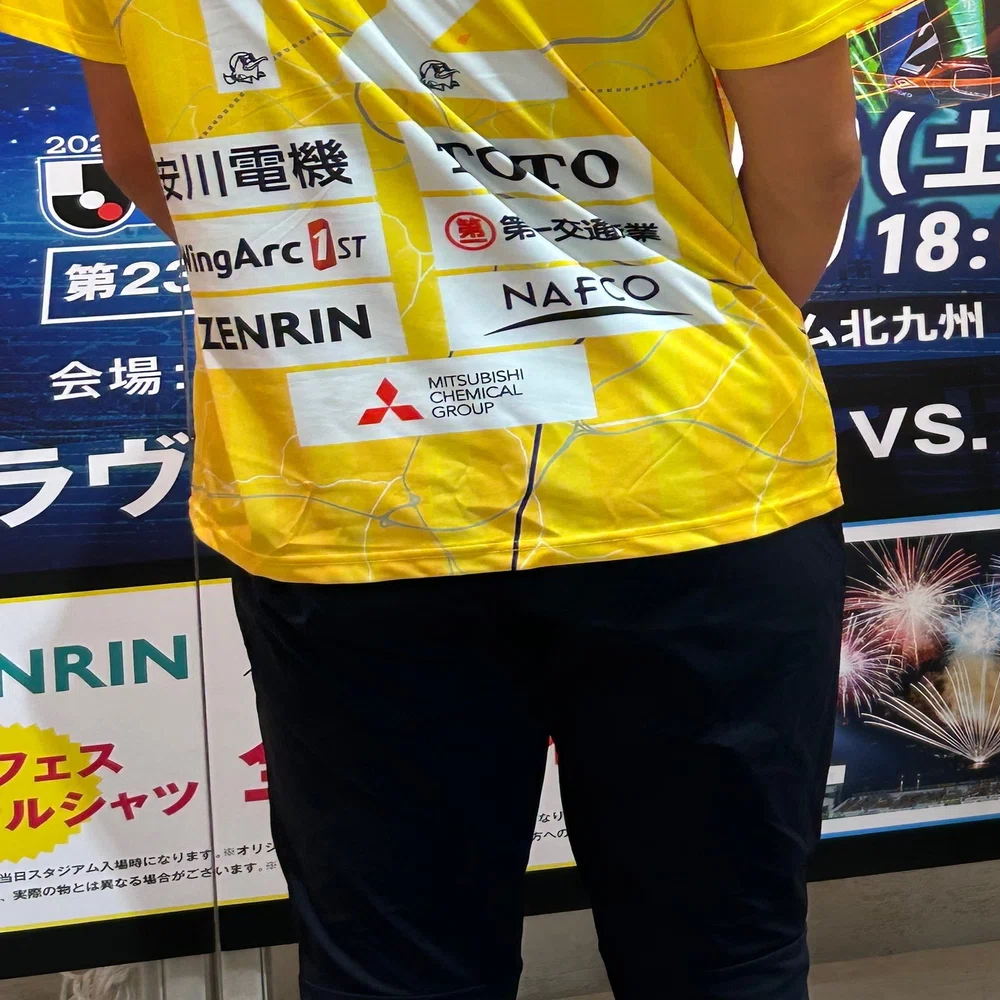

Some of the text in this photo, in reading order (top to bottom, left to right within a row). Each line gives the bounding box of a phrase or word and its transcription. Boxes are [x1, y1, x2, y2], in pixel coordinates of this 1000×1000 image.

[156, 138, 353, 201] 安川電機
[437, 142, 620, 189] TOTO
[499, 214, 662, 243] 第一交通業
[503, 274, 660, 310] NAFCO
[197, 304, 373, 351] ZENRIN
[427, 368, 525, 389] MITSUBISHI
[429, 385, 524, 404] CHEMICAL
[431, 401, 495, 420] GROUP
[5, 781, 199, 832] ルシャツ
